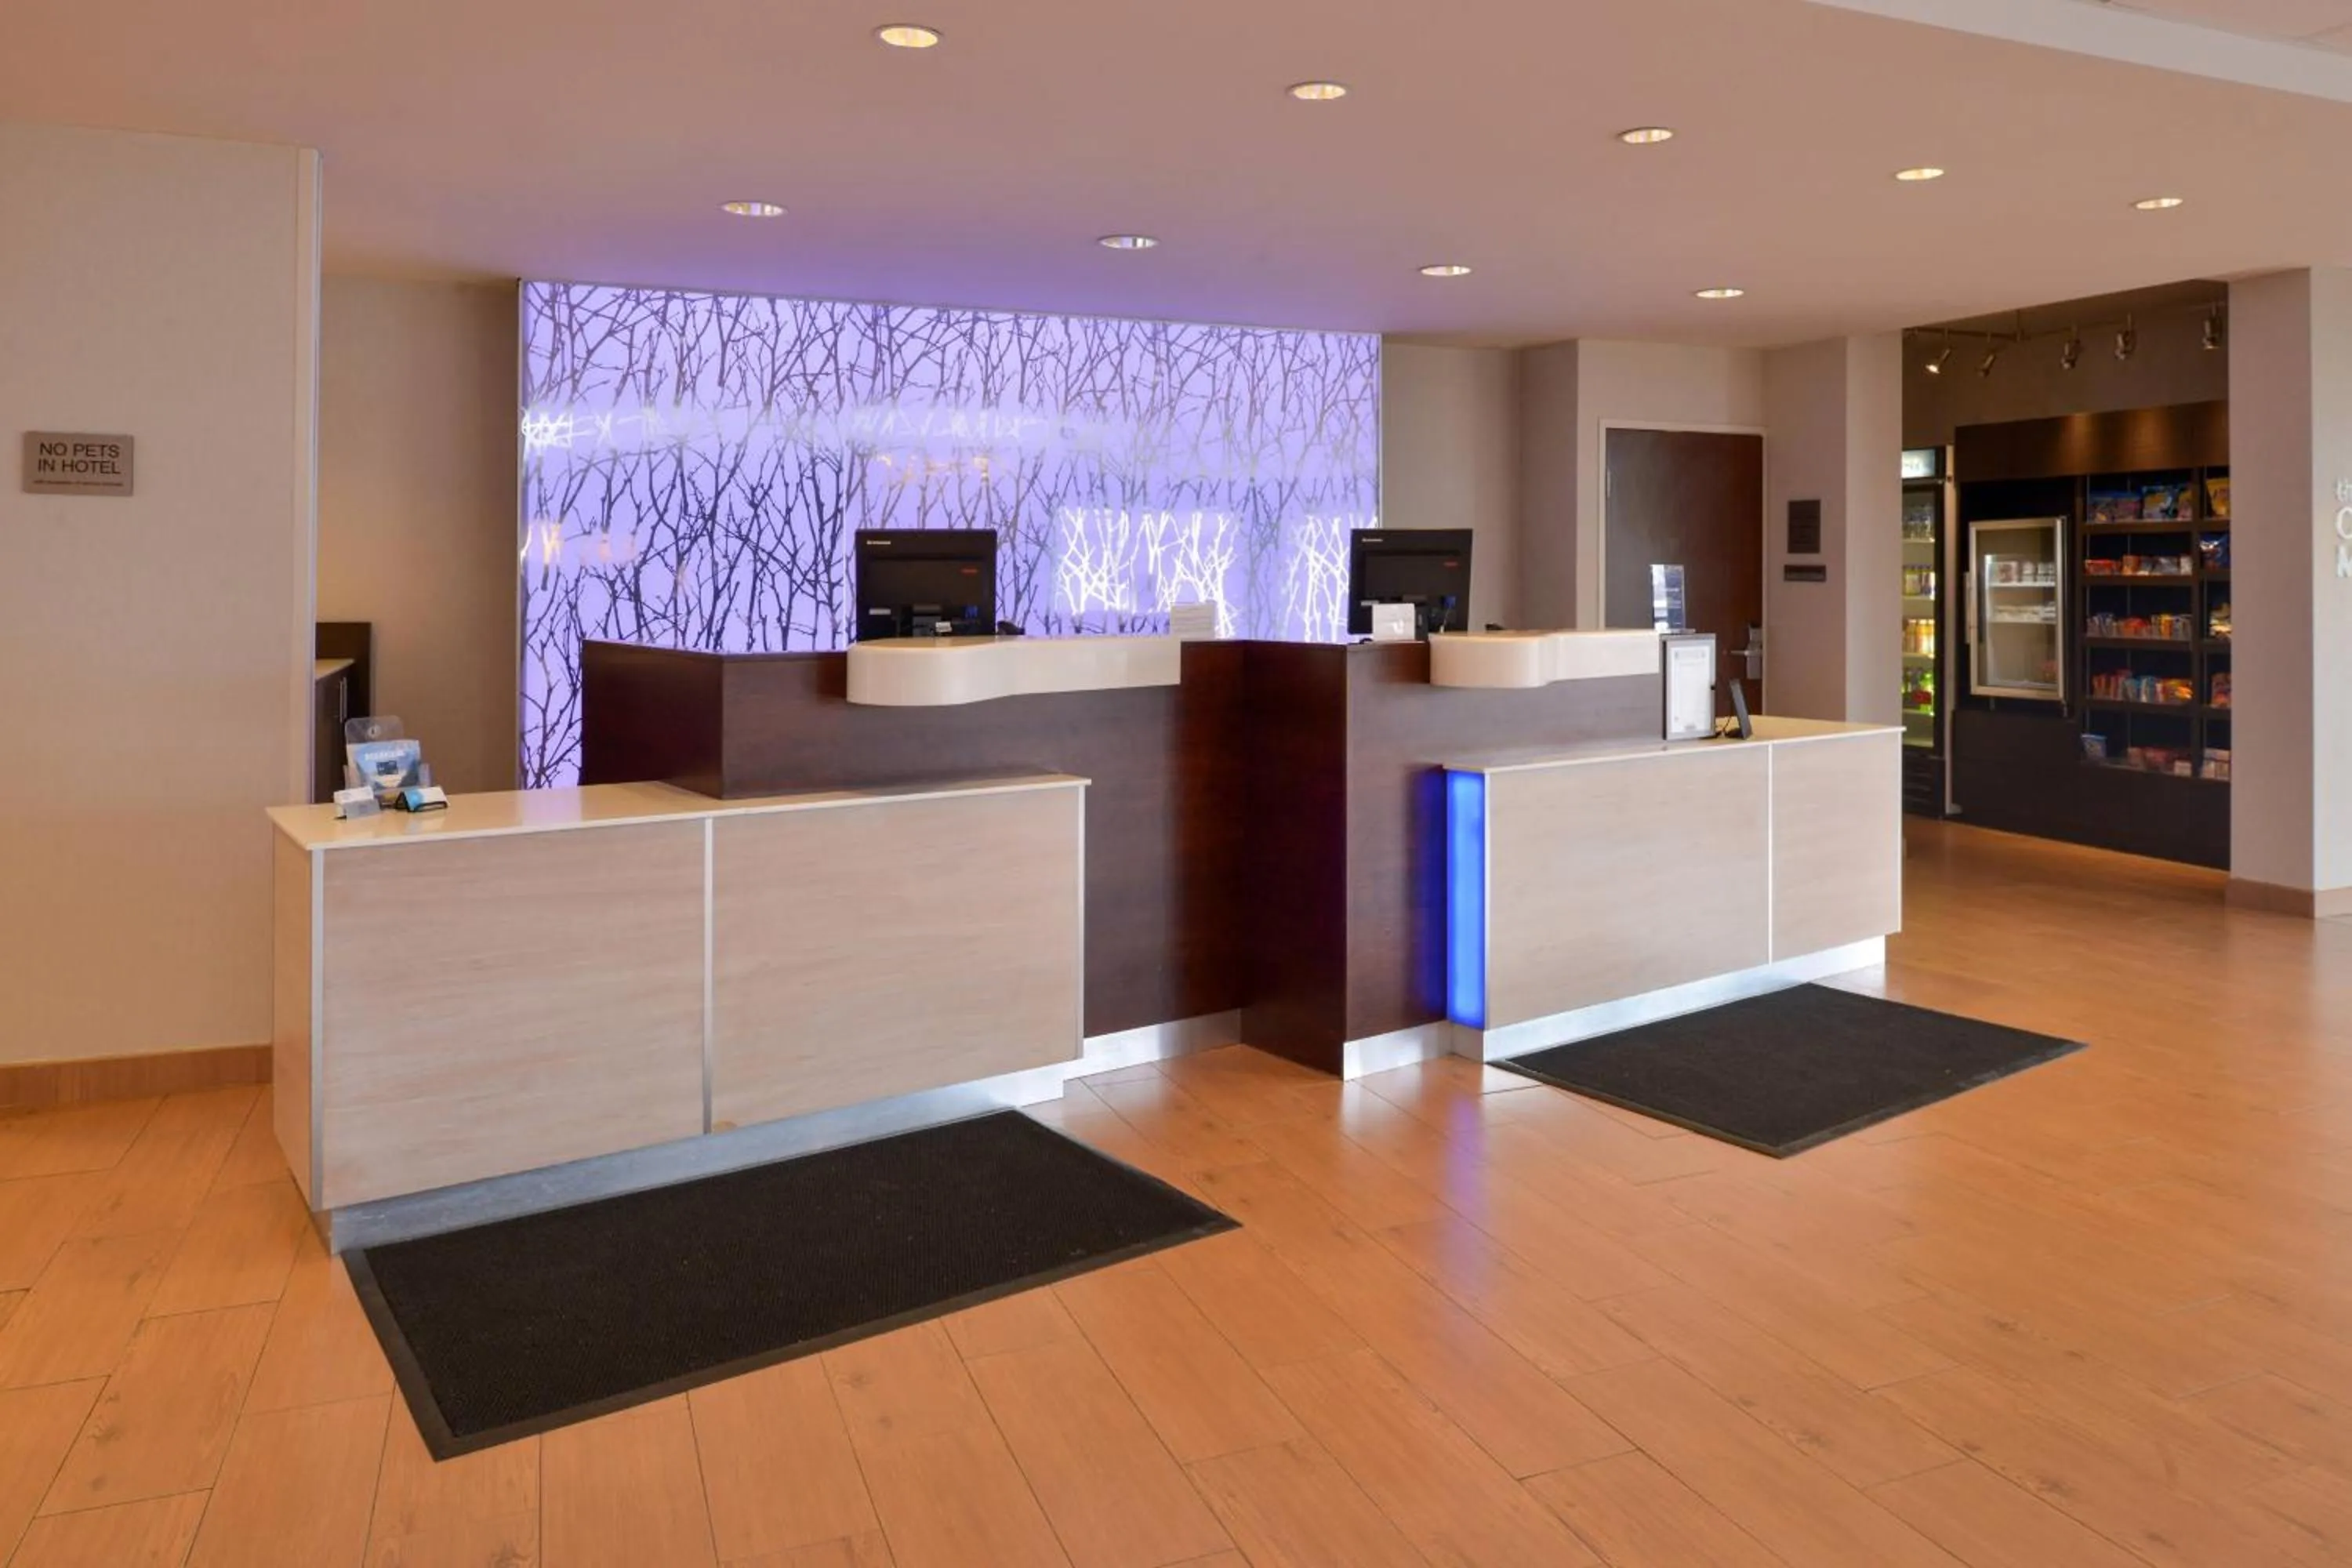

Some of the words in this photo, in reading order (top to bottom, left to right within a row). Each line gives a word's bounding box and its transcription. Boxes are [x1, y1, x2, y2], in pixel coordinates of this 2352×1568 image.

[39, 441, 67, 456] NO
[72, 443, 120, 459] PETS
[38, 458, 56, 473] IN
[62, 459, 121, 474] HOTEL
